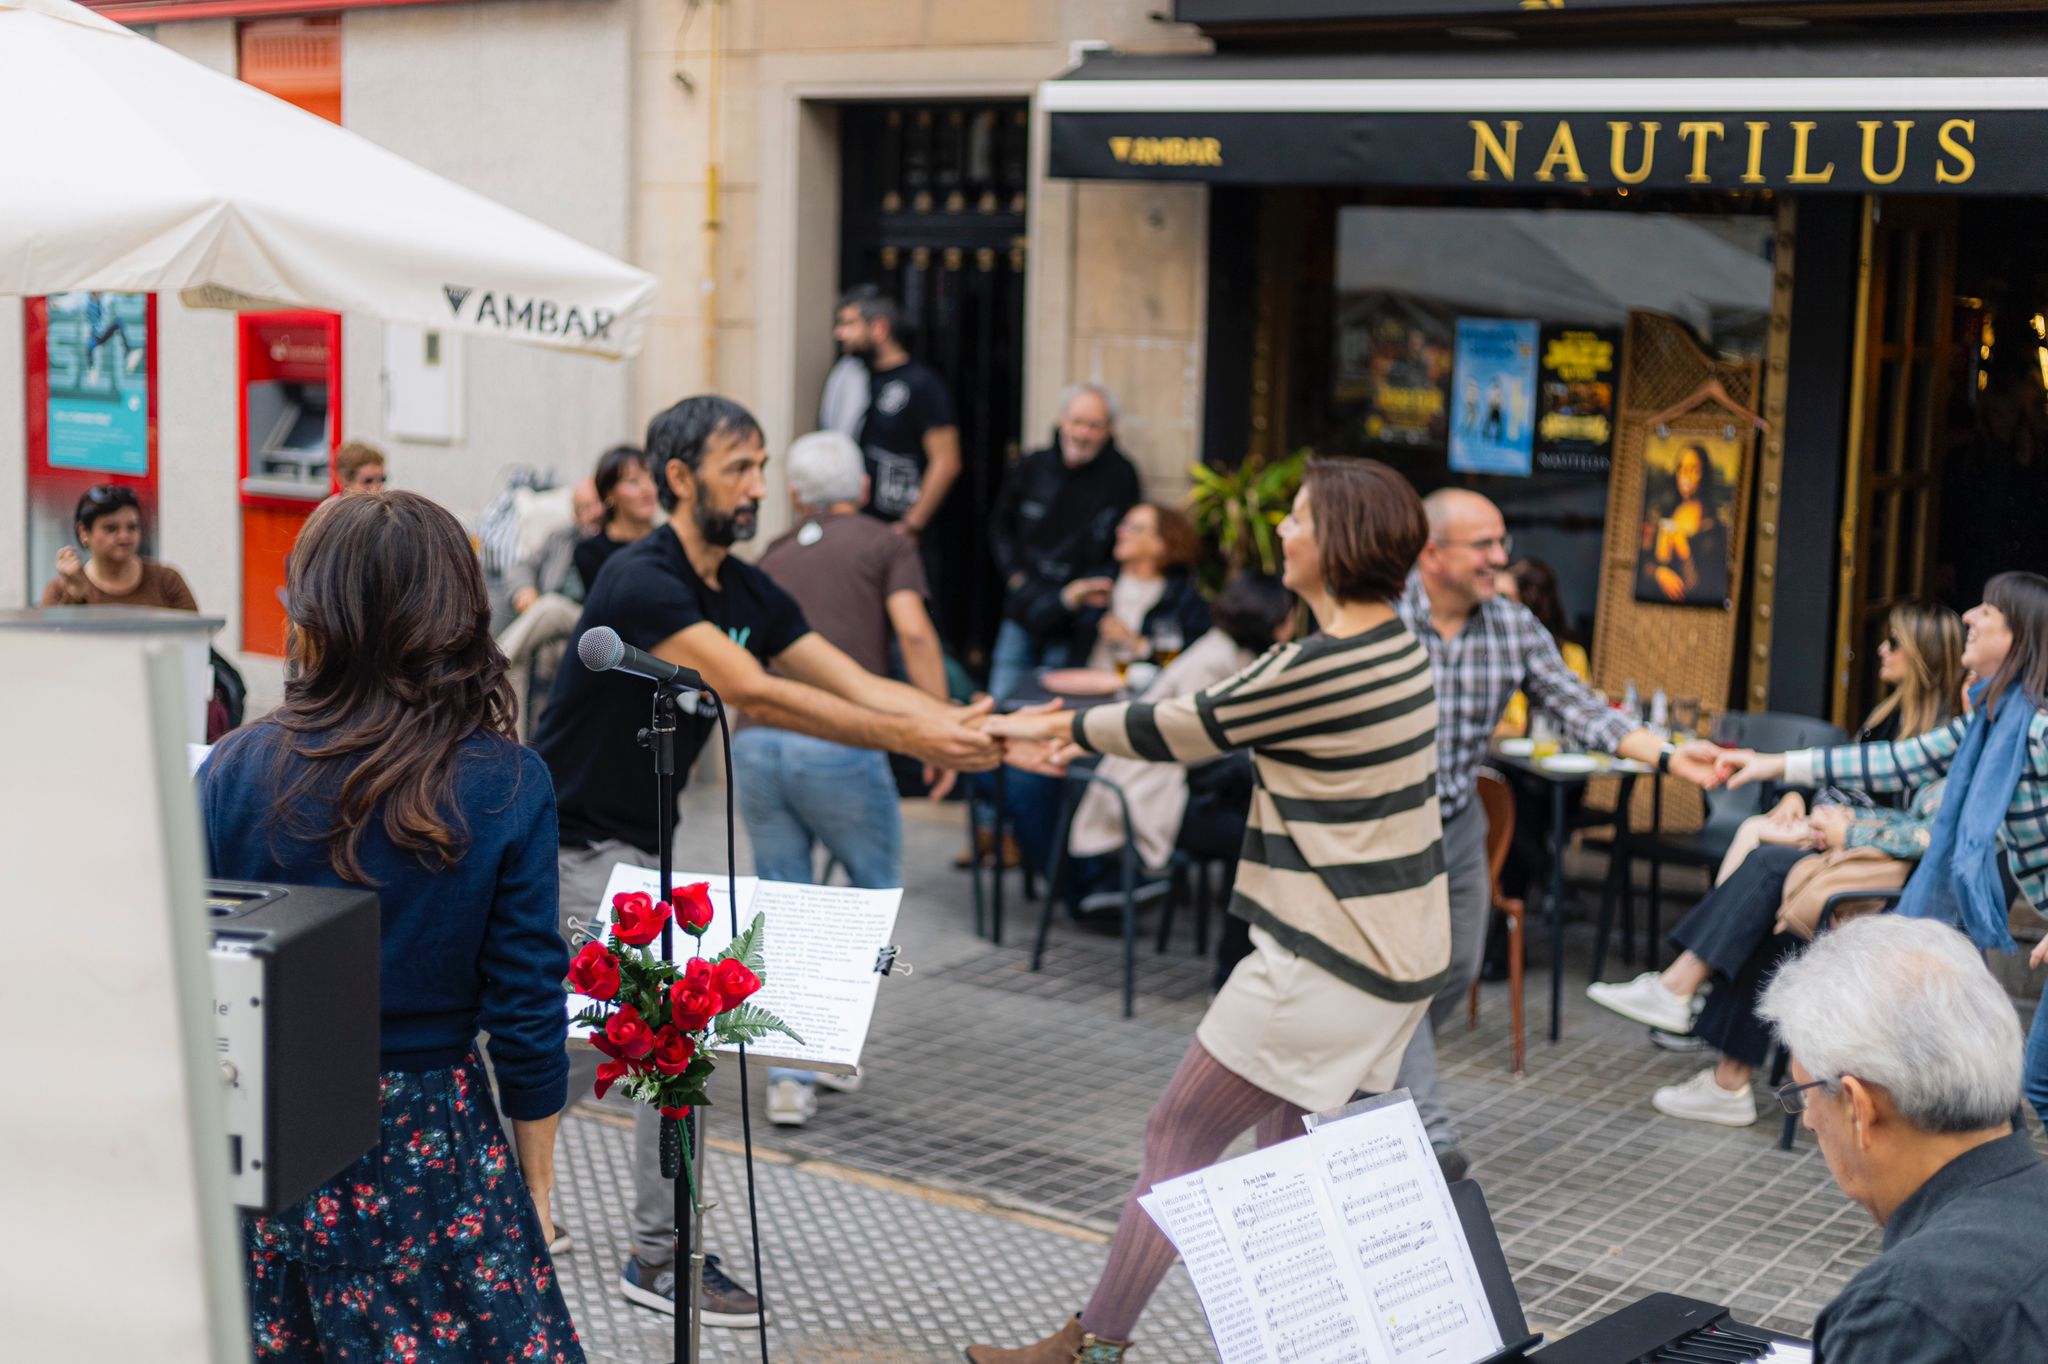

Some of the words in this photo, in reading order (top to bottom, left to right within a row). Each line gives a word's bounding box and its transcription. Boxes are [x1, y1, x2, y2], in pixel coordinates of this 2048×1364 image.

[1129, 137, 1224, 167] AMBAR
[1467, 119, 1977, 184] NAUTILUS
[476, 290, 615, 340] AMBAR
